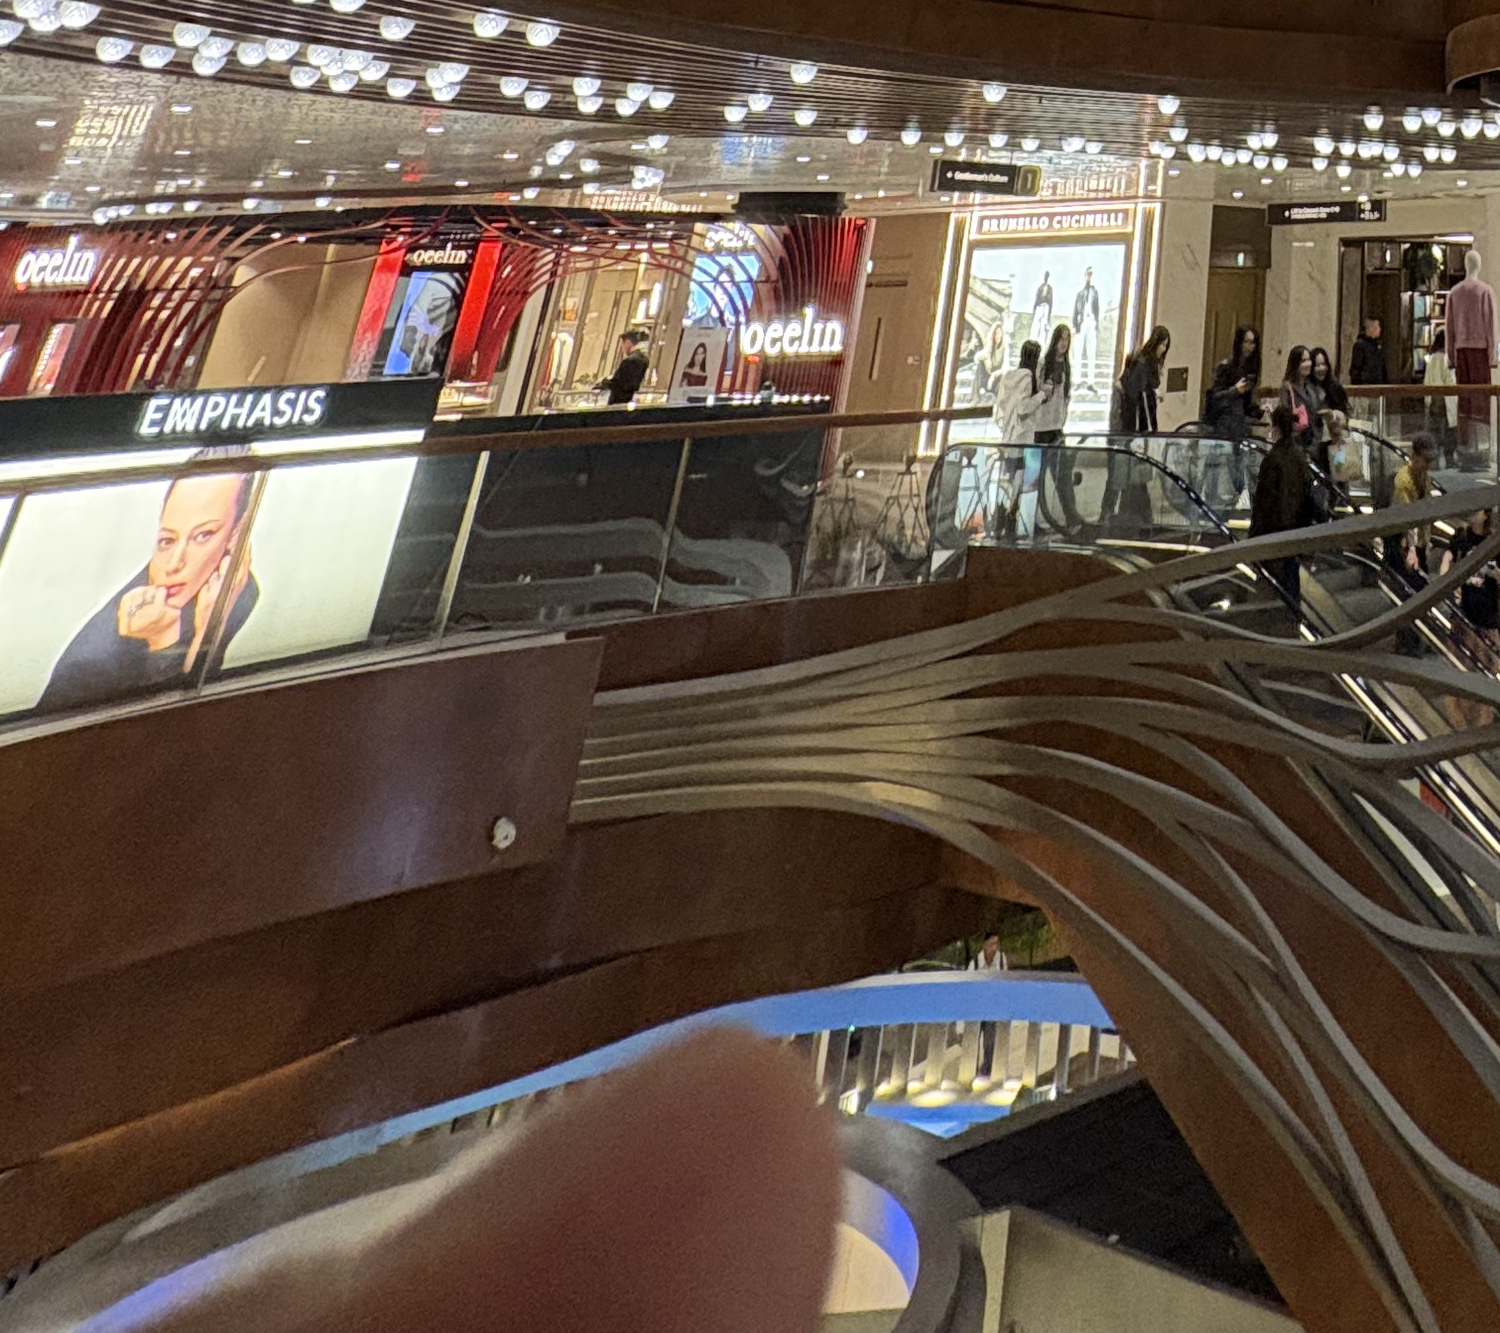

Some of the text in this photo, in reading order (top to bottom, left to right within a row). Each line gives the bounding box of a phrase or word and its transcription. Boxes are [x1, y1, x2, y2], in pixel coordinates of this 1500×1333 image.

[982, 212, 1124, 232] BRUNELLO CUCINELLI
[138, 388, 327, 437] EMPHASIS
